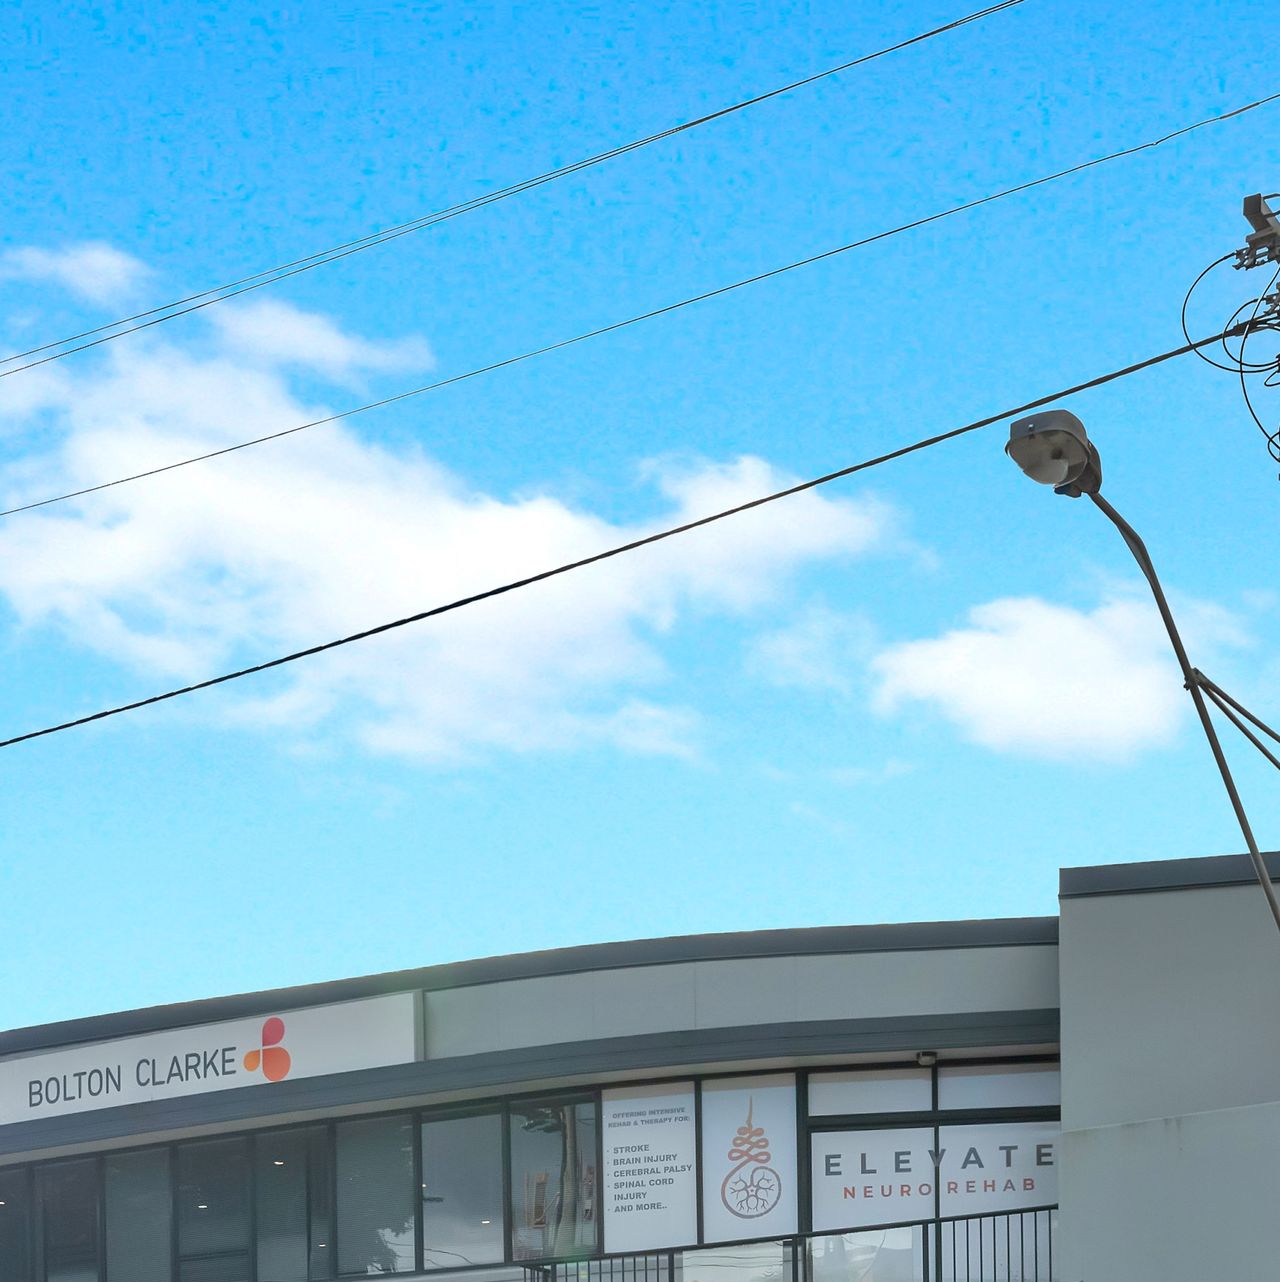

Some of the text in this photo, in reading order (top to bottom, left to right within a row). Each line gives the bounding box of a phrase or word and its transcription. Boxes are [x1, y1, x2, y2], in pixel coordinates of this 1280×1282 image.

[28, 1046, 237, 1108] BOLTON CLARKE
[612, 1107, 685, 1119] OFFERING INTENSIVE
[641, 1117, 672, 1126] THERAPY
[613, 1144, 650, 1154] STROKE
[613, 1153, 678, 1166] BRAIN INJURY
[824, 1143, 1055, 1176] ELEVATE
[613, 1164, 693, 1178] CEREBRAL PALSY
[613, 1178, 674, 1190] SPINAL CORD
[843, 1178, 1035, 1199] NEURO REHAB
[614, 1191, 648, 1201] INJURY
[614, 1204, 633, 1213] AND
